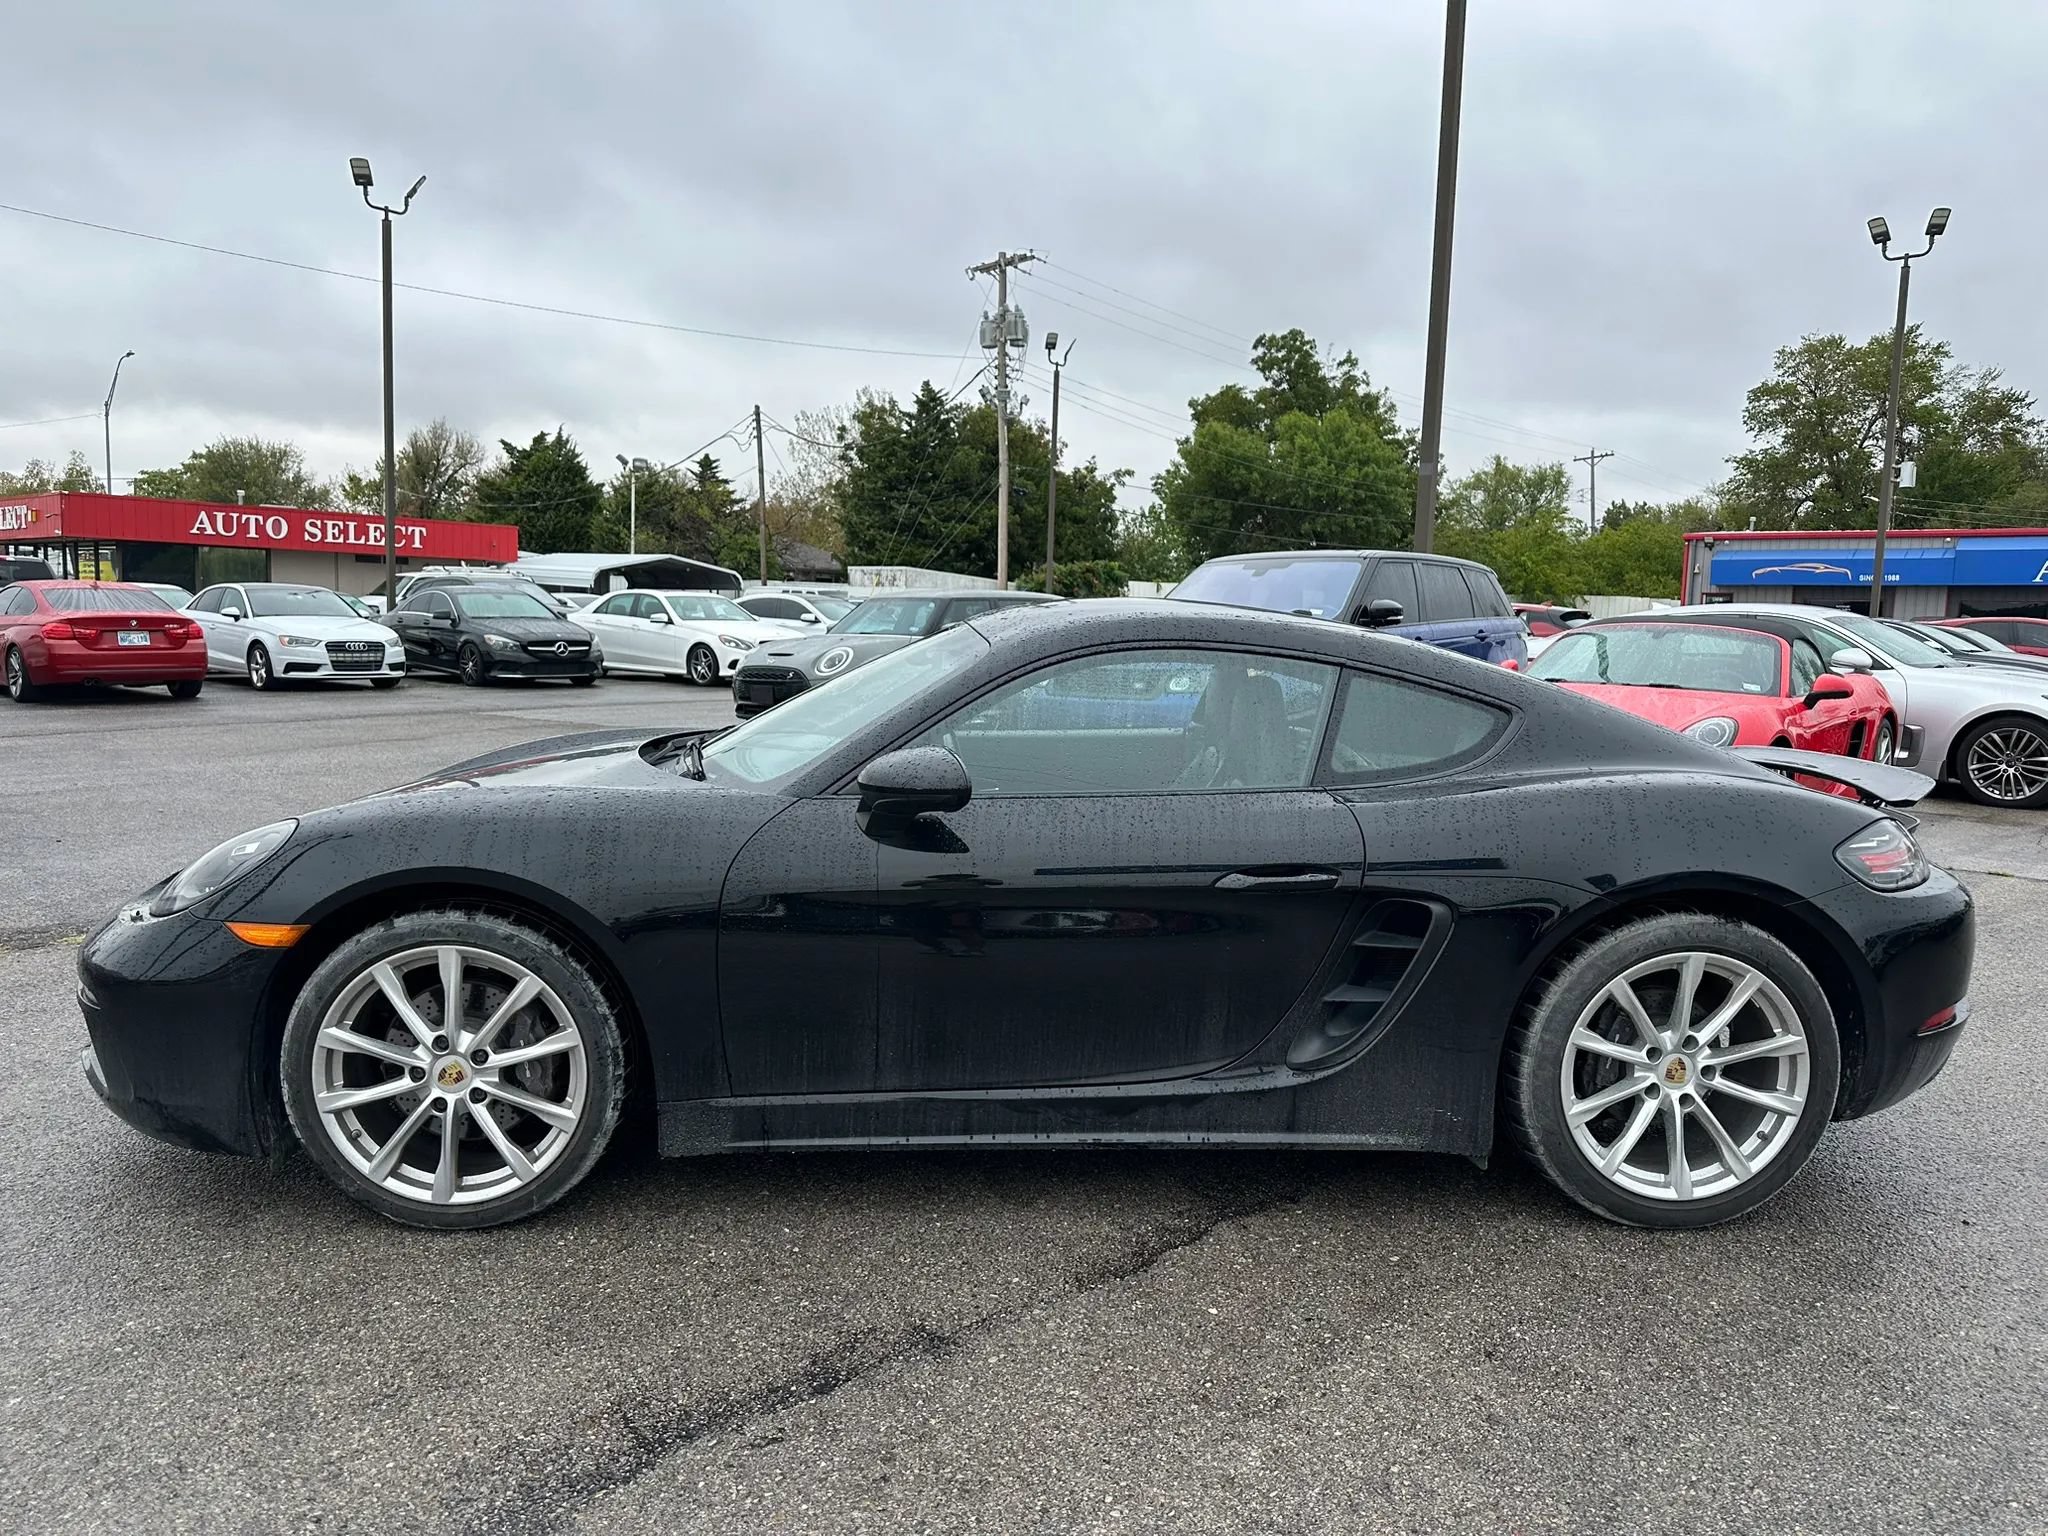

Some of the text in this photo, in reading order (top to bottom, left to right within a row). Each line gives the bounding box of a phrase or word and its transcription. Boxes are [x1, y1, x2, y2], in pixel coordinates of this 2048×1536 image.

[190, 510, 427, 548] AUTO SELECT
[1884, 574, 1900, 582] 1988
